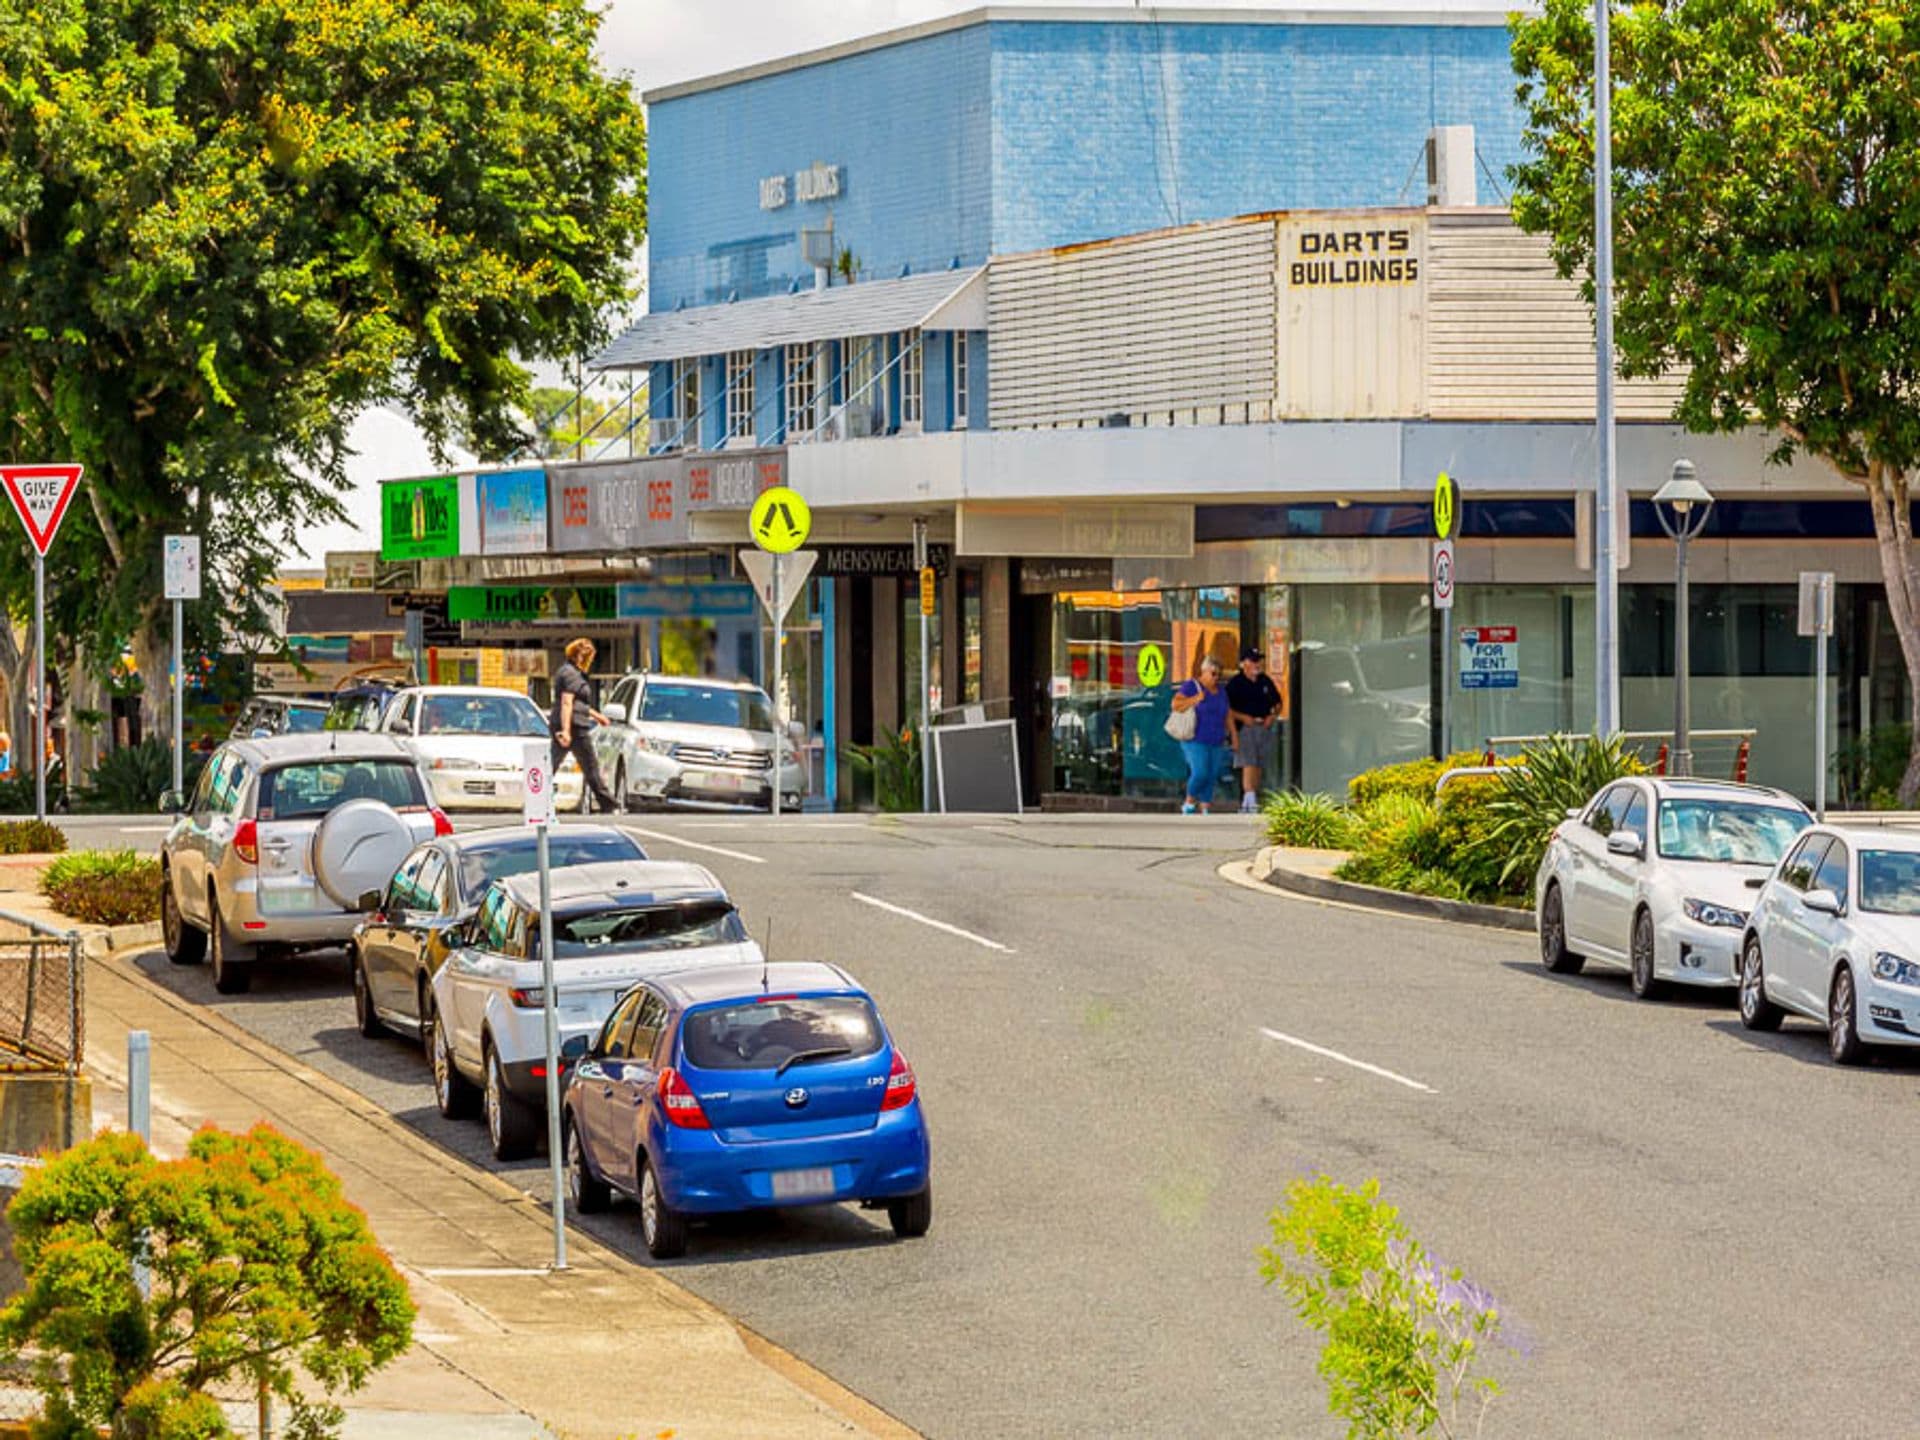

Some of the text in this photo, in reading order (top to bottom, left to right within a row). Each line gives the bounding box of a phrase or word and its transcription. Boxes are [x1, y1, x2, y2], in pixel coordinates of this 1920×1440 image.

[1301, 230, 1409, 254] DARTS
[1291, 258, 1418, 285] BUILDINGS
[23, 482, 58, 497] GIVE
[30, 499, 53, 511] WAY
[485, 589, 550, 612] Indie
[1476, 645, 1503, 656] FOR
[1472, 657, 1505, 669] RENT
